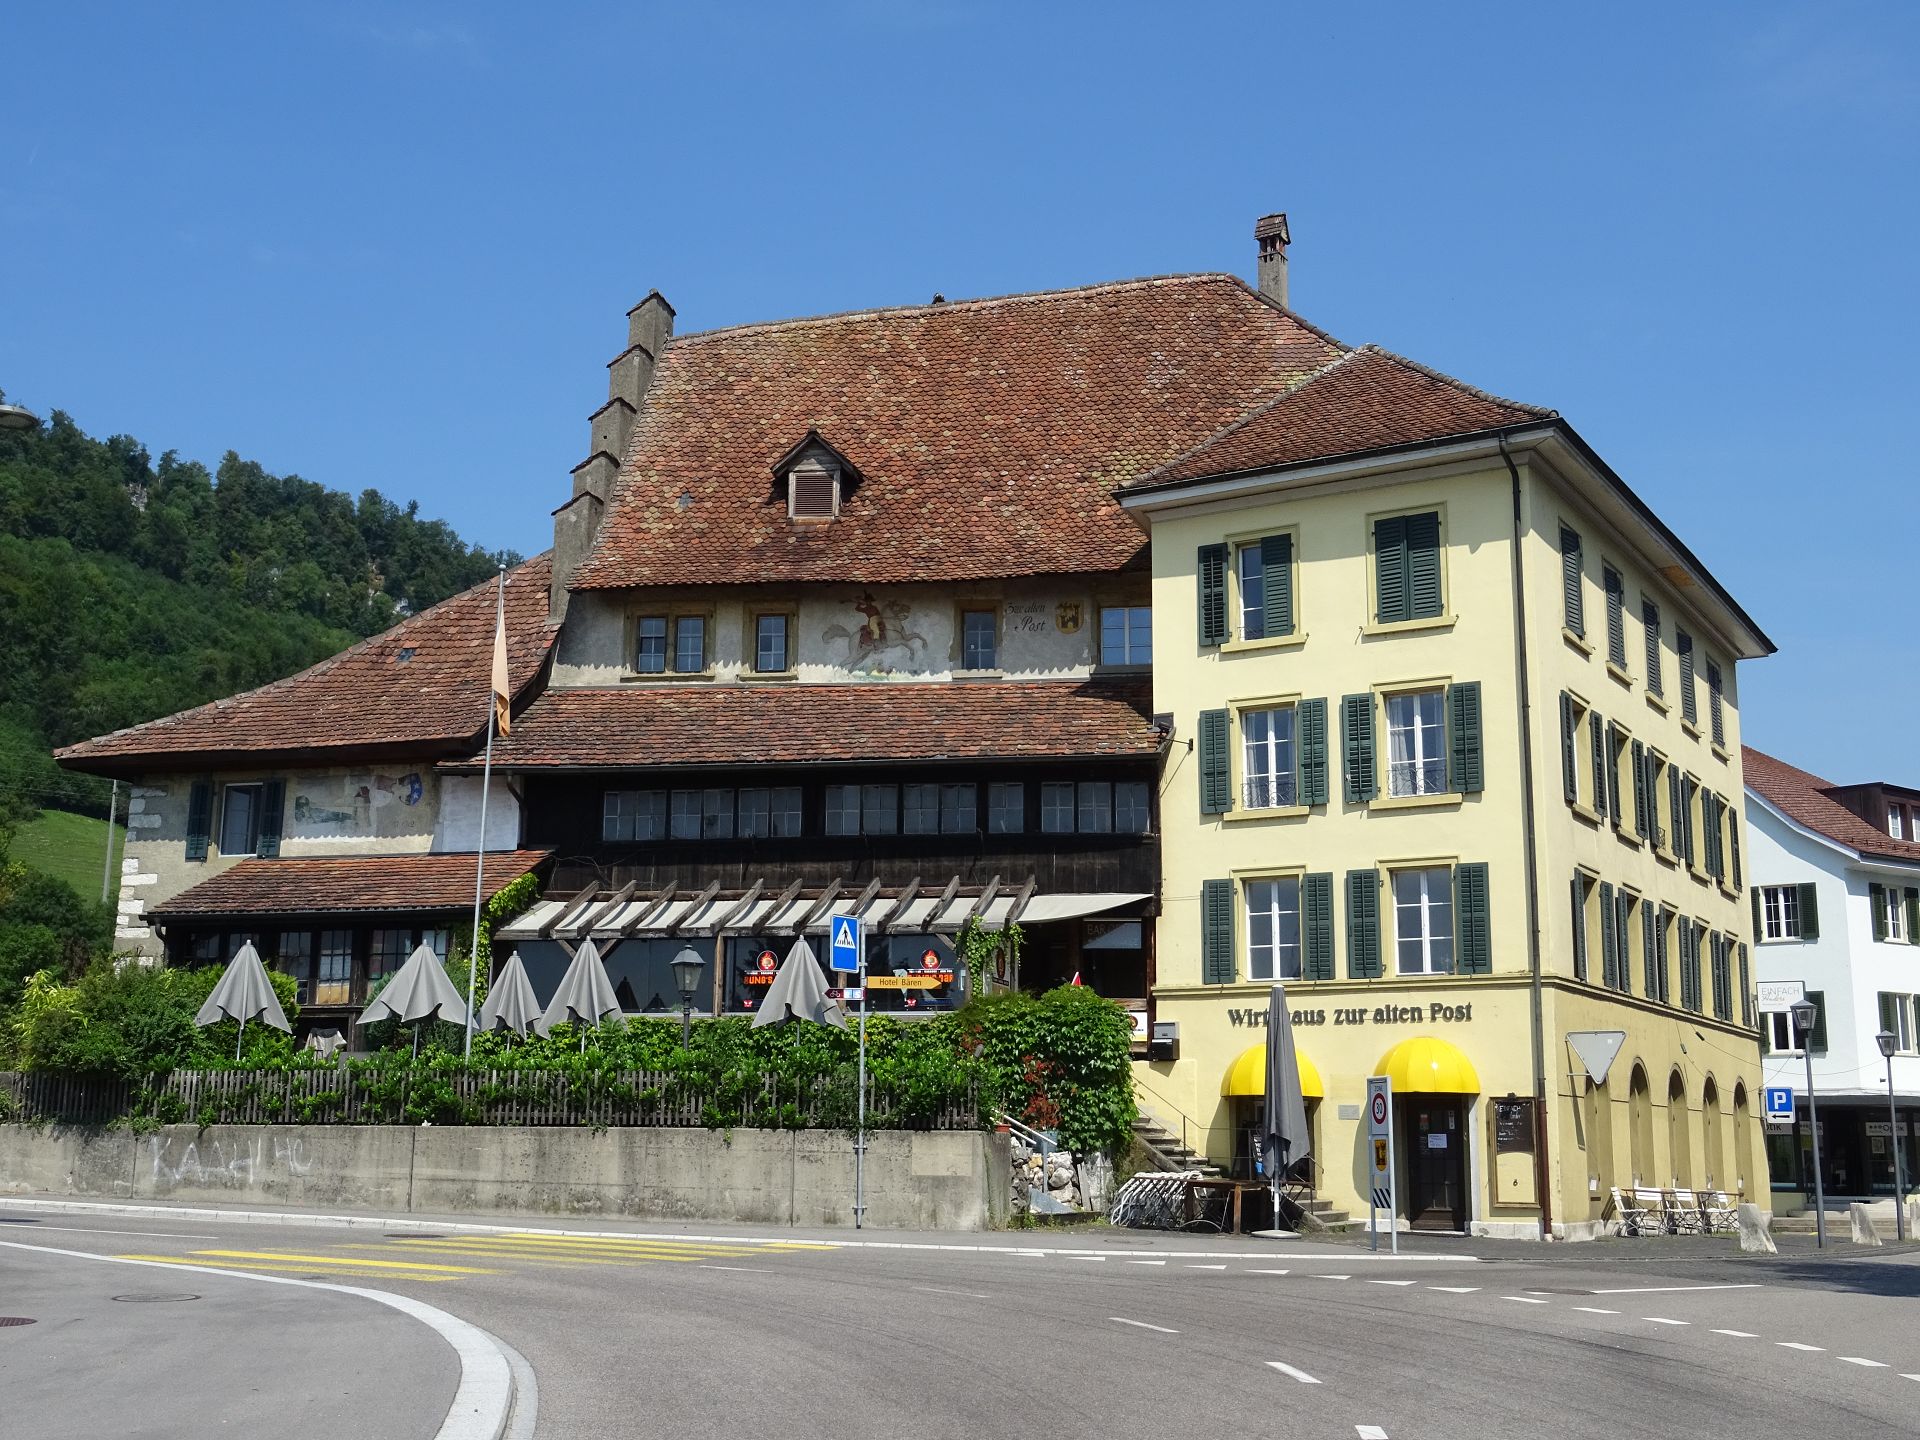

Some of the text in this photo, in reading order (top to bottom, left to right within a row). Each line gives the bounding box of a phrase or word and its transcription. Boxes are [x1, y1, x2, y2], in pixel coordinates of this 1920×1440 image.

[1014, 615, 1047, 632] Post
[879, 977, 898, 986] Hotel
[901, 977, 922, 987] Bären
[1761, 986, 1800, 996] EINFACH
[1227, 1001, 1473, 1028] Wirtaus zur alten Post
[1773, 1091, 1787, 1110] P
[1375, 1102, 1383, 1115] 30
